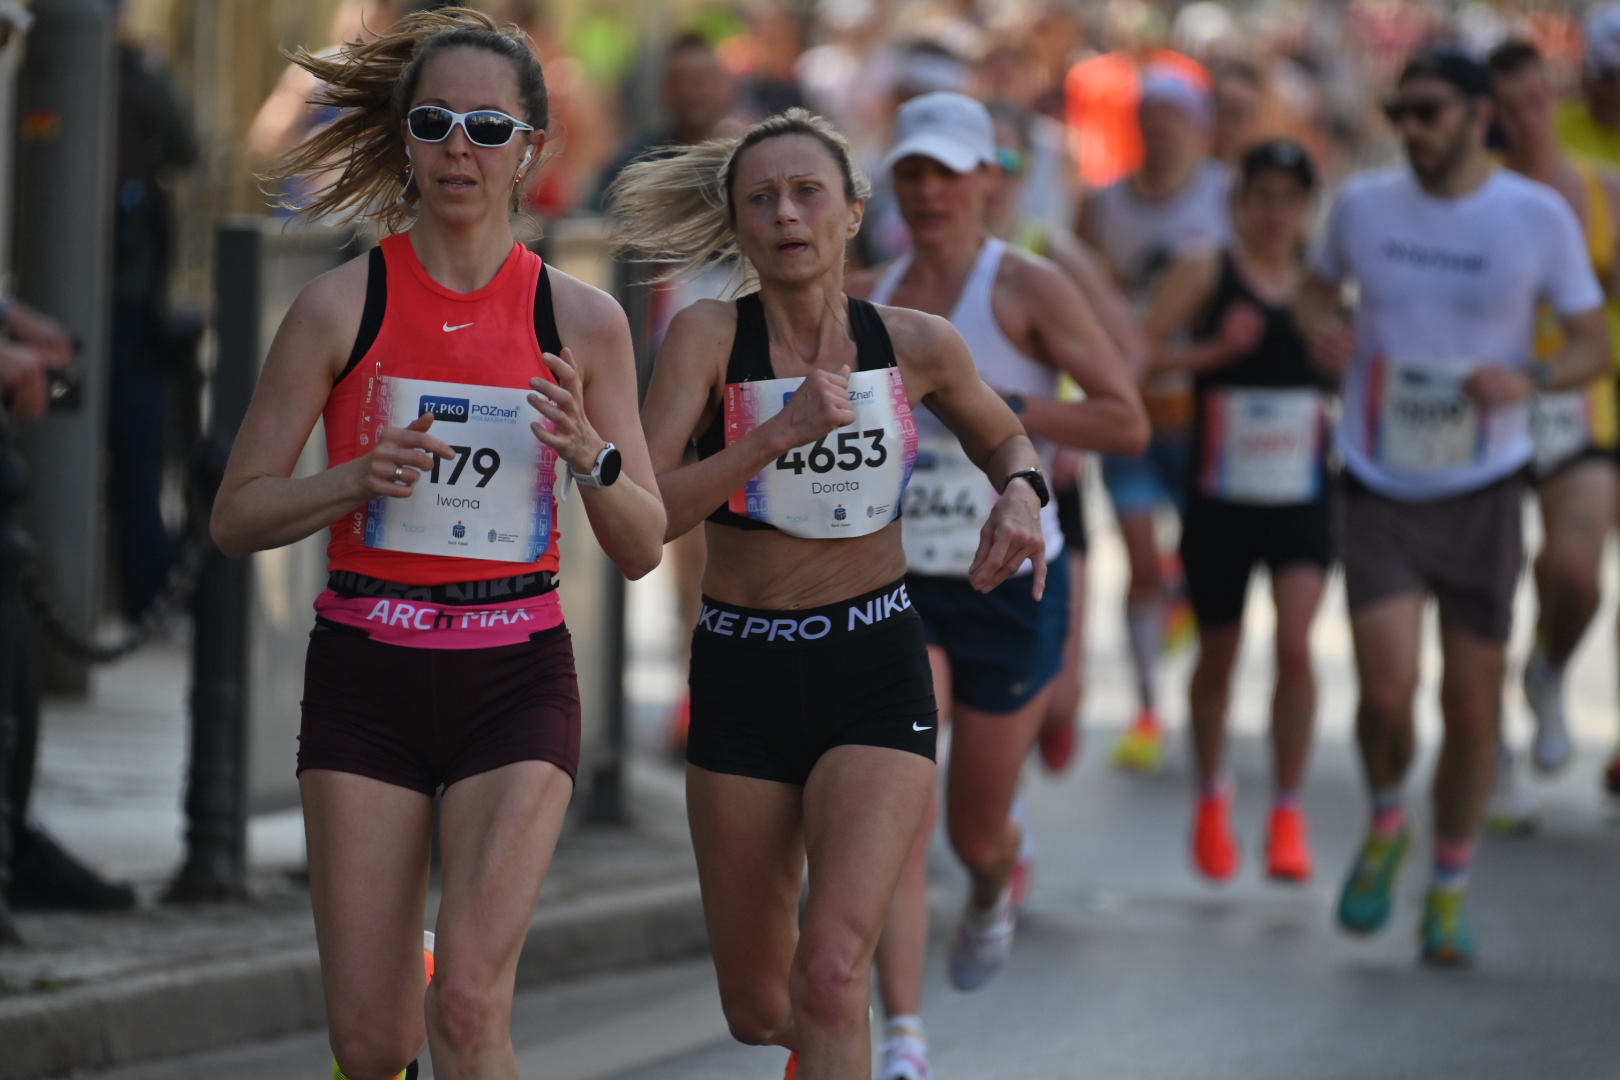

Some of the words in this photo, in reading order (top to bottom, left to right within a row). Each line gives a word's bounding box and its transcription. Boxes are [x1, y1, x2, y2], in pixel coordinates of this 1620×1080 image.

[423, 402, 465, 416] 17.PKO
[776, 428, 887, 475] 4653
[425, 445, 501, 488] 179
[811, 480, 860, 495] Dorota
[436, 493, 481, 510] Iwona
[353, 512, 363, 535] K40
[740, 615, 832, 642] PRO
[847, 583, 912, 632] NIKE
